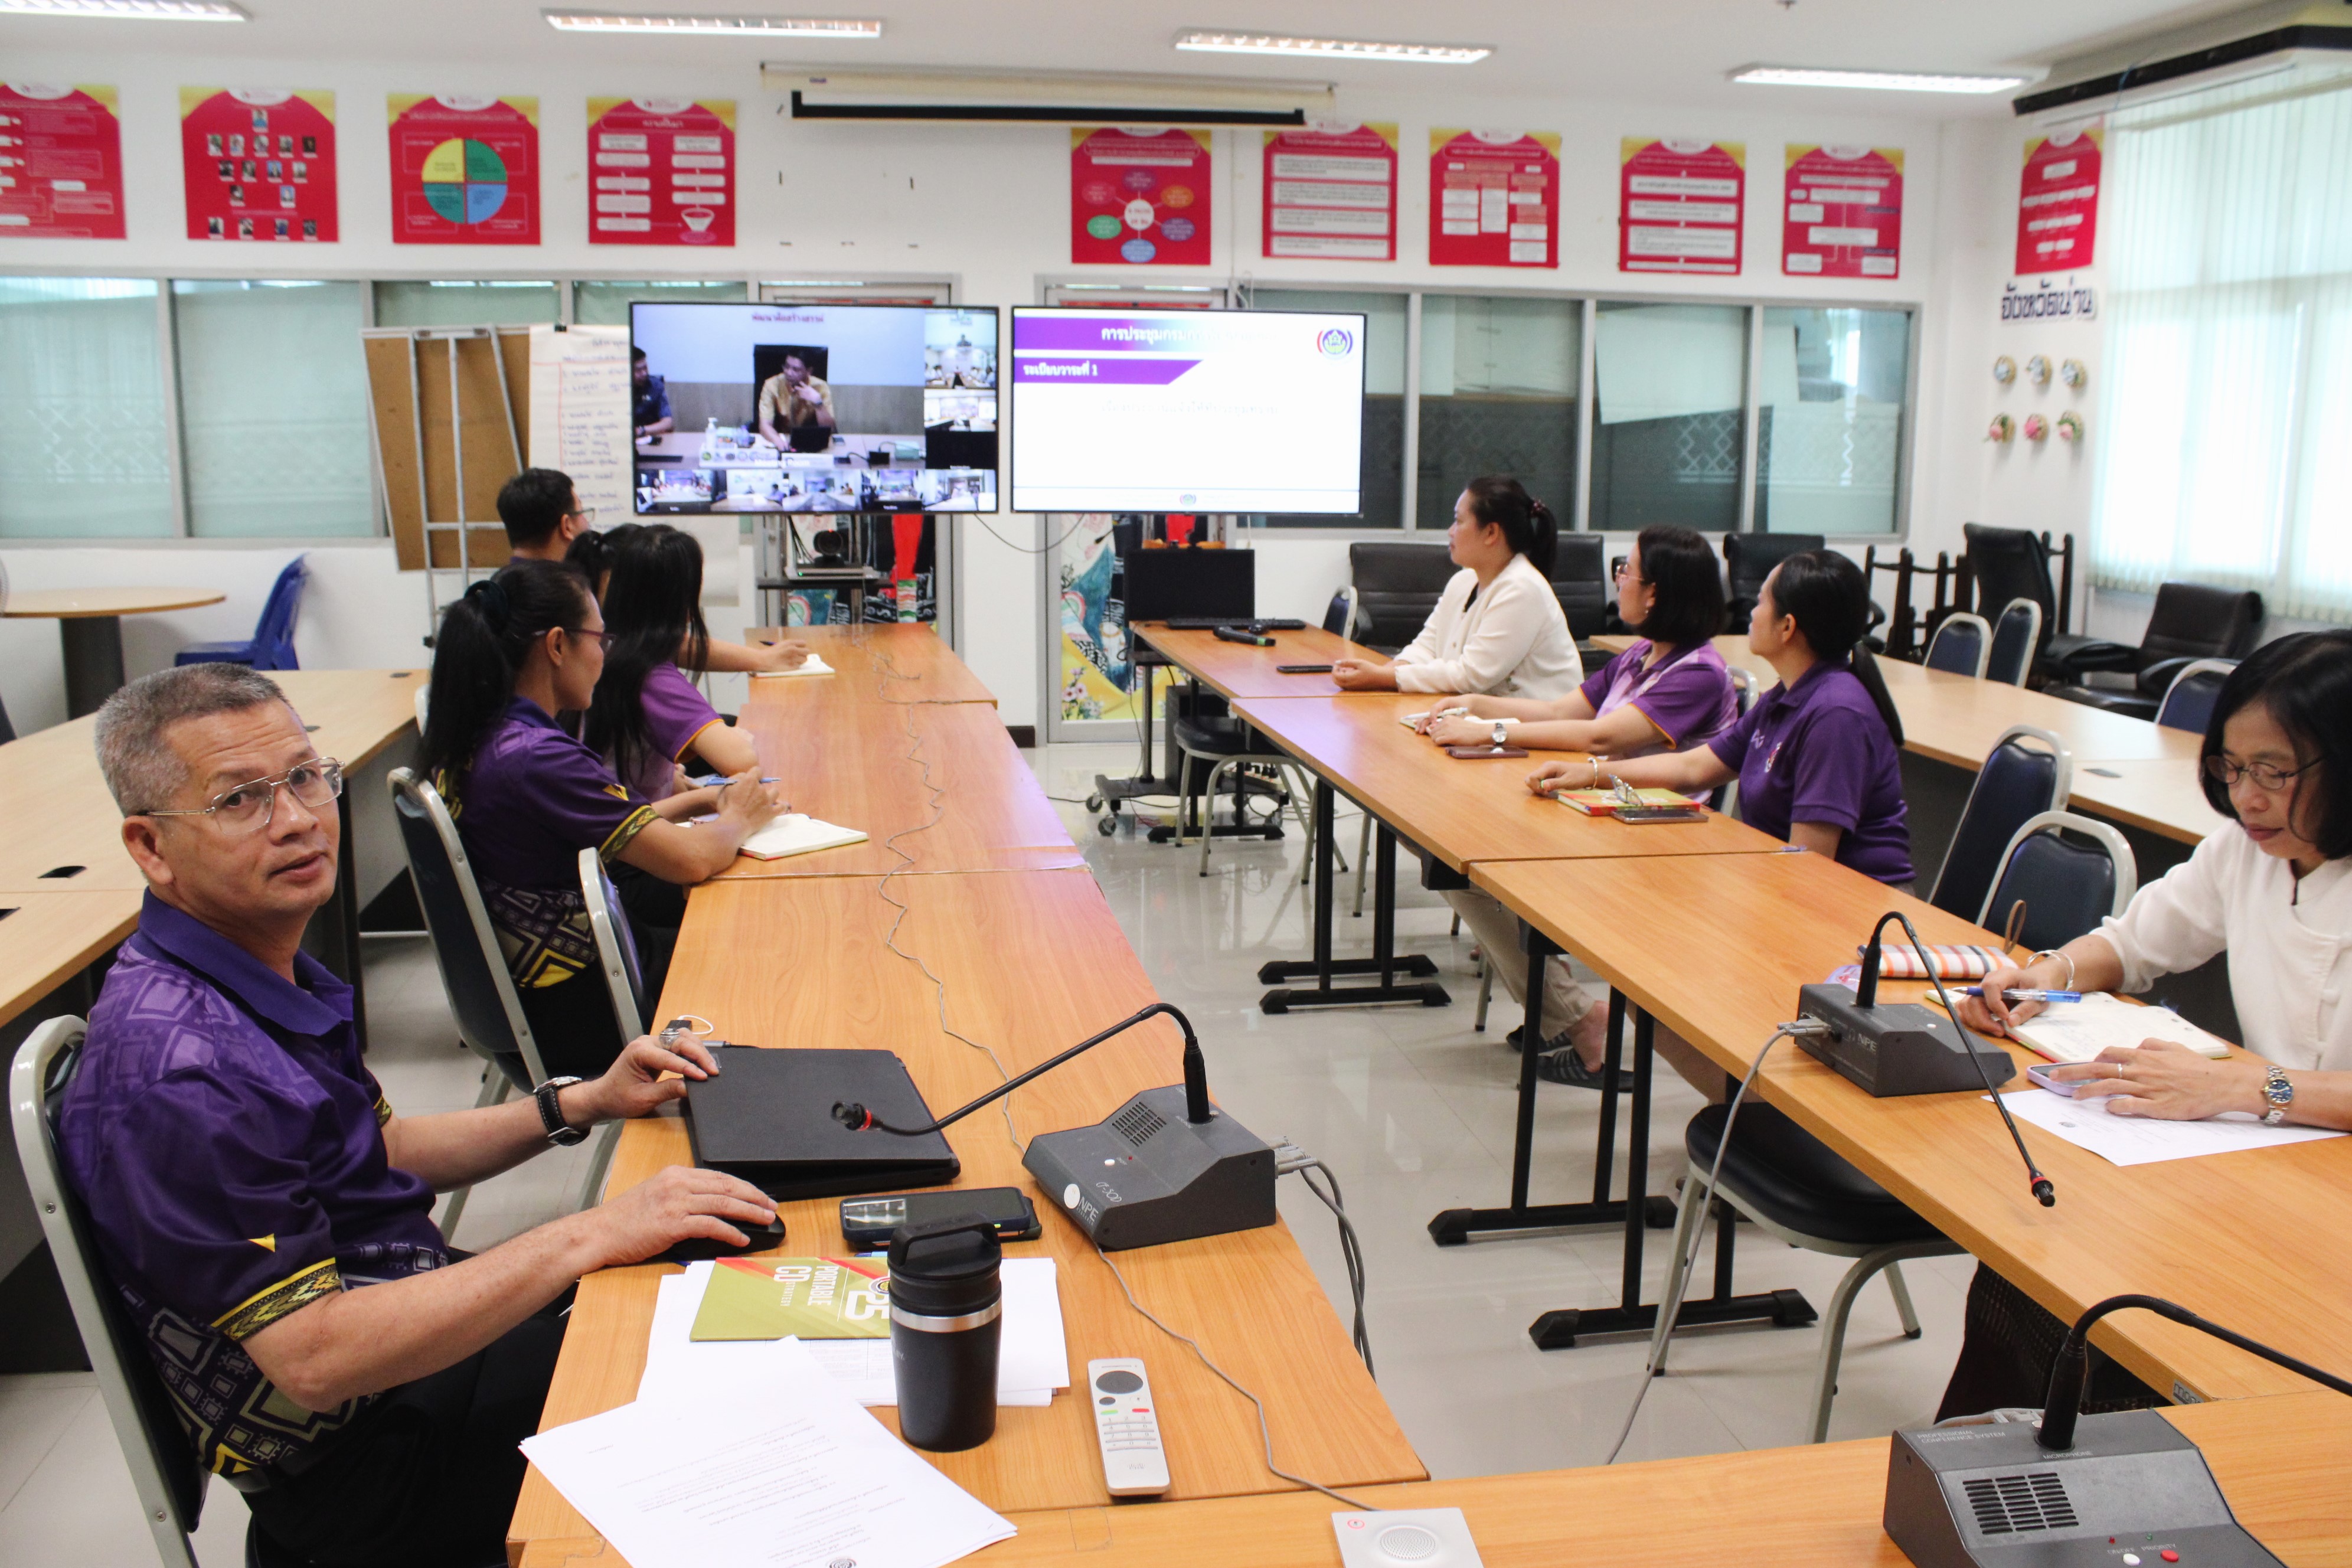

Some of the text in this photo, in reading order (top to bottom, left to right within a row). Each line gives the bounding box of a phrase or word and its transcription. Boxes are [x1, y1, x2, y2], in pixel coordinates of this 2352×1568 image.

[2001, 276, 2094, 320] จังหวัดน่าน
[1092, 364, 1098, 376] 1
[1079, 1196, 1099, 1222] NPE
[773, 1266, 812, 1282] CD
[808, 1266, 839, 1306] PORTABLE
[1917, 1430, 1974, 1439] PROFESSIONAL
[1921, 1431, 2006, 1443] CONFERENCE SYSTEM
[2043, 1451, 2094, 1459] MICROPHONE
